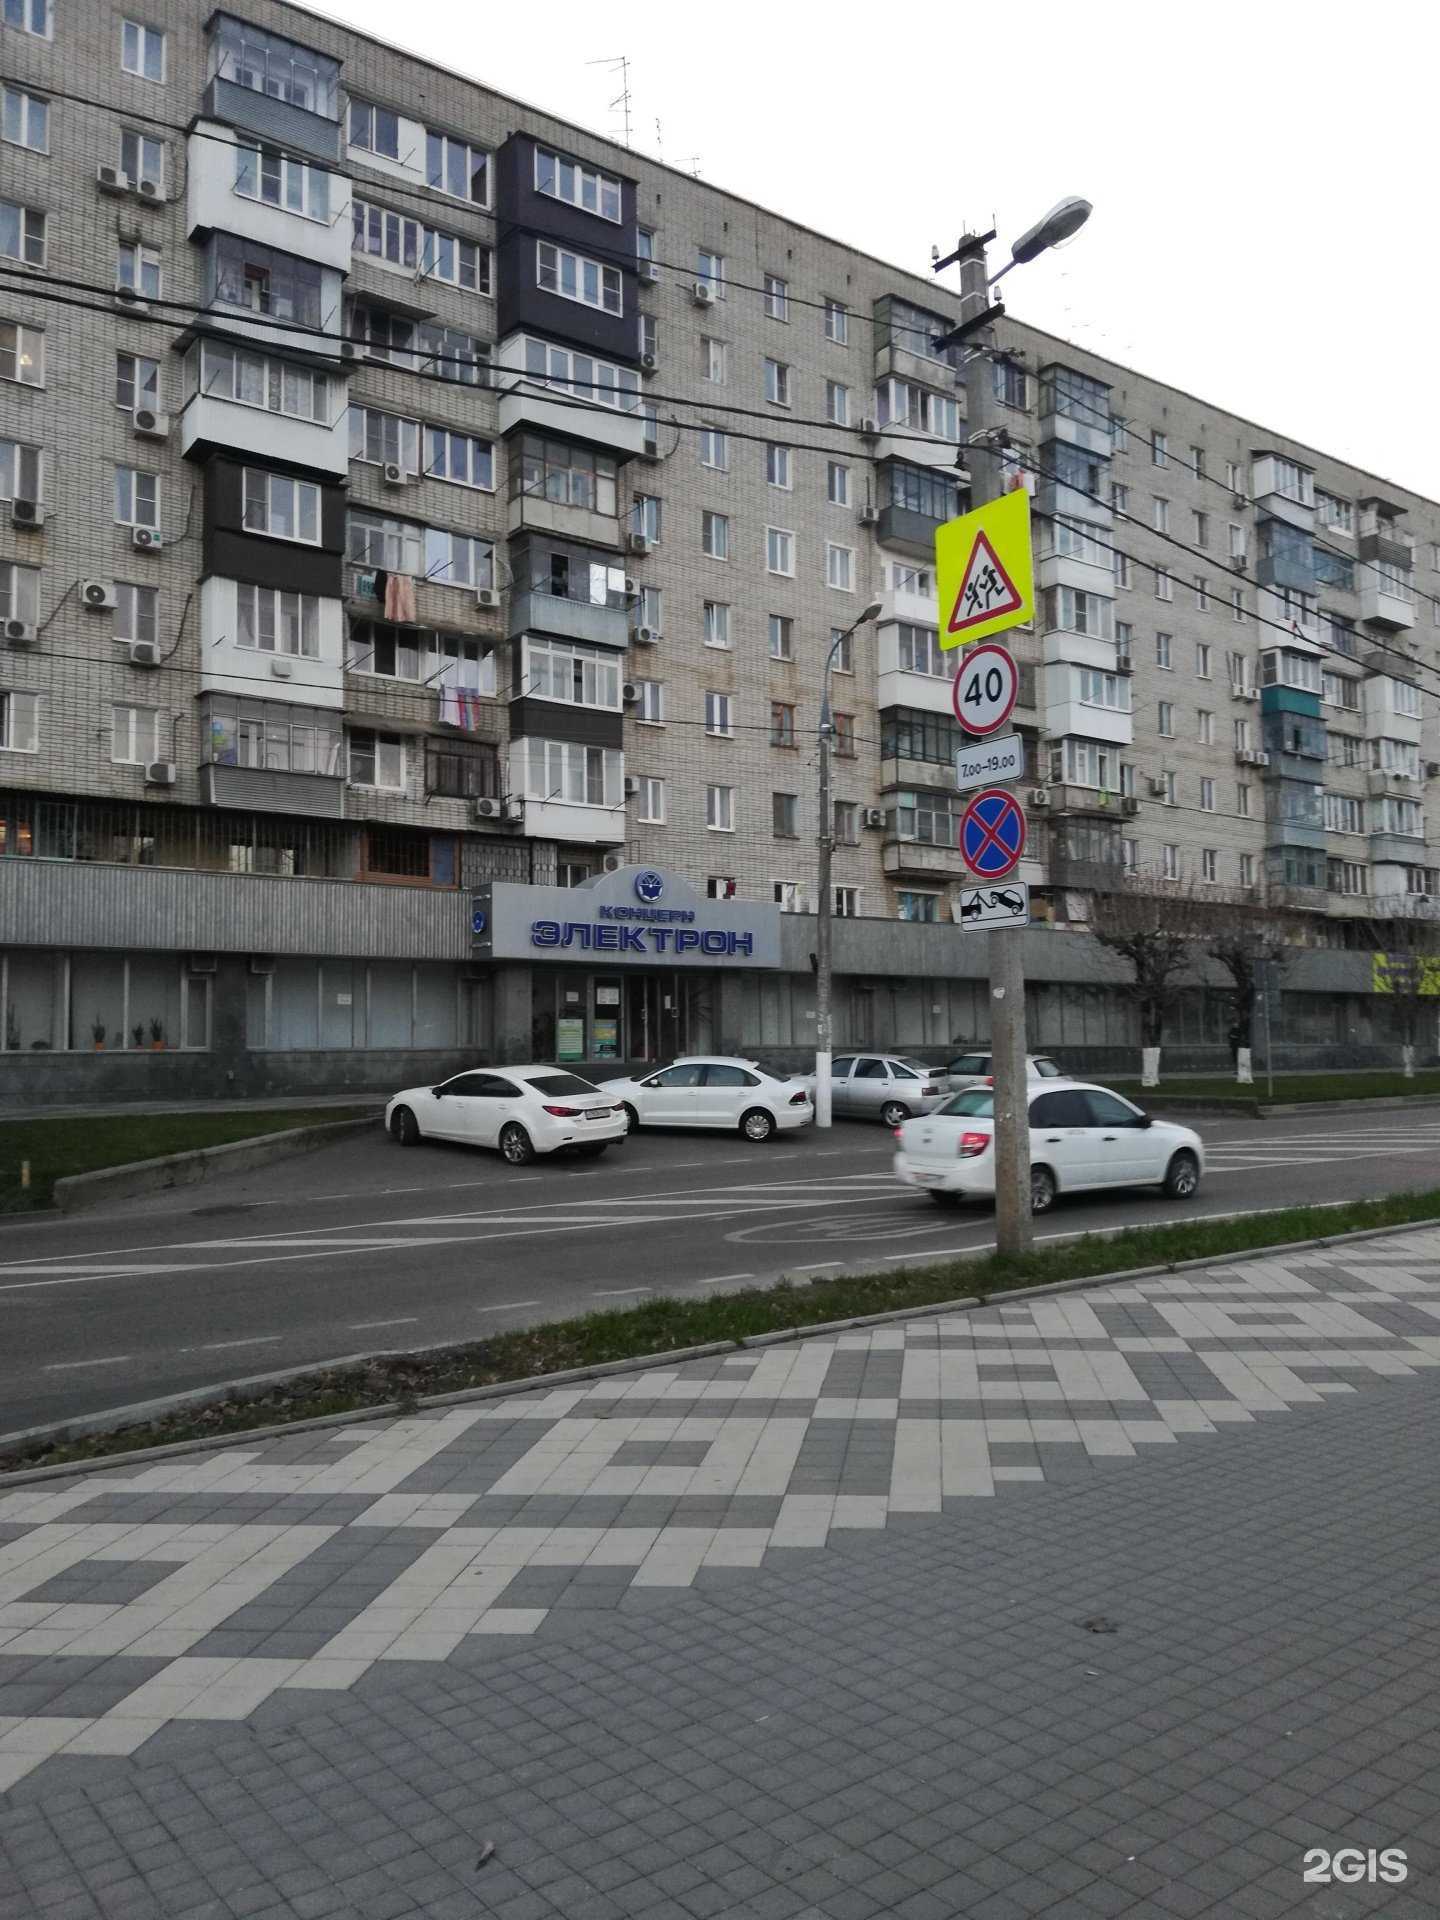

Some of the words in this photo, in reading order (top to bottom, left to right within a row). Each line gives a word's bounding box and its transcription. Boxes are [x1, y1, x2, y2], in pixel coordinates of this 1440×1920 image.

[964, 667, 1003, 706] 40
[599, 905, 696, 923] КОНЦЕРН
[531, 920, 753, 956] ЭЛЕКТРОН
